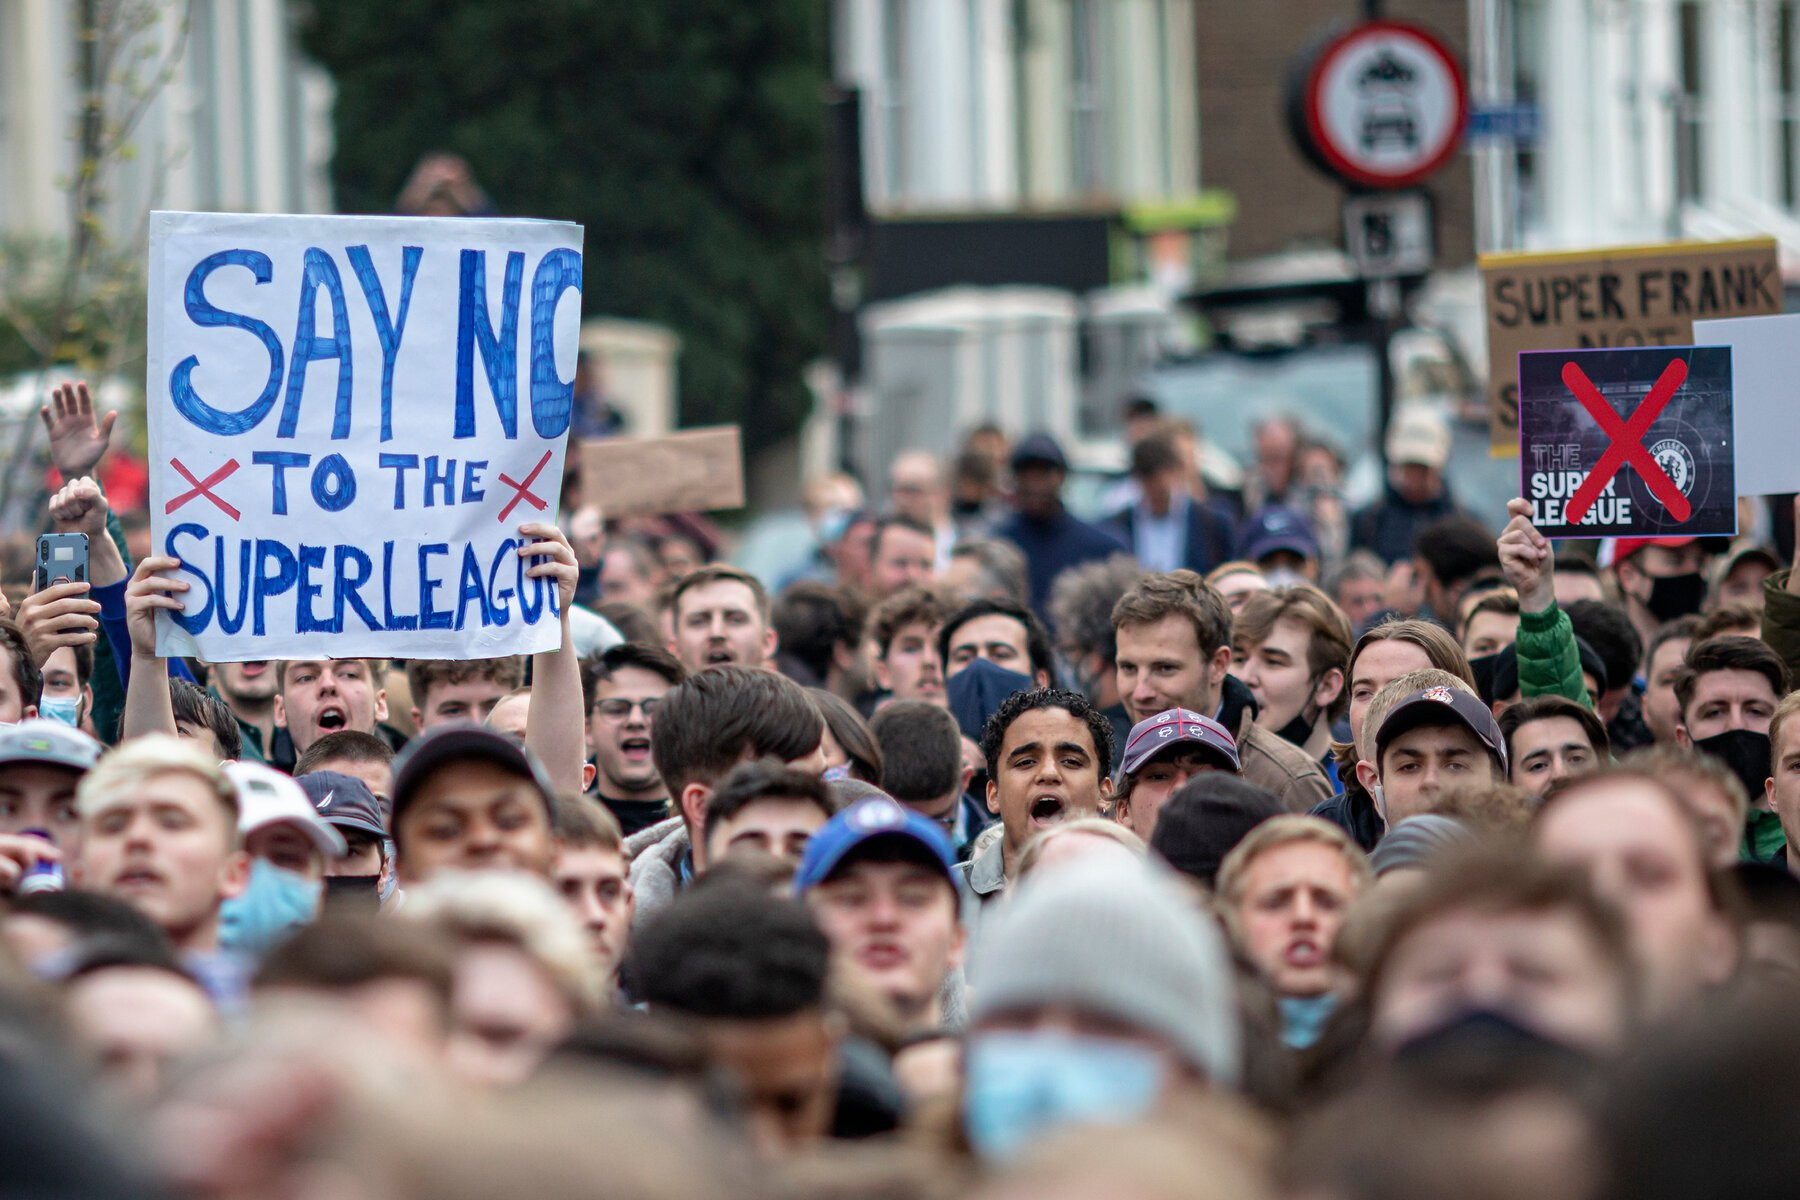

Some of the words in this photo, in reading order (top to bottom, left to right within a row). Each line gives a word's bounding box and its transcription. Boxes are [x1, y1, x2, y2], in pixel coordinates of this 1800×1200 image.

[1494, 270, 1626, 328] SUPER
[1638, 260, 1778, 316] FRANK
[169, 245, 424, 442] SAY
[453, 247, 582, 440] NO
[252, 451, 357, 516] TO
[379, 453, 489, 511] THE
[1530, 443, 1582, 471] THE
